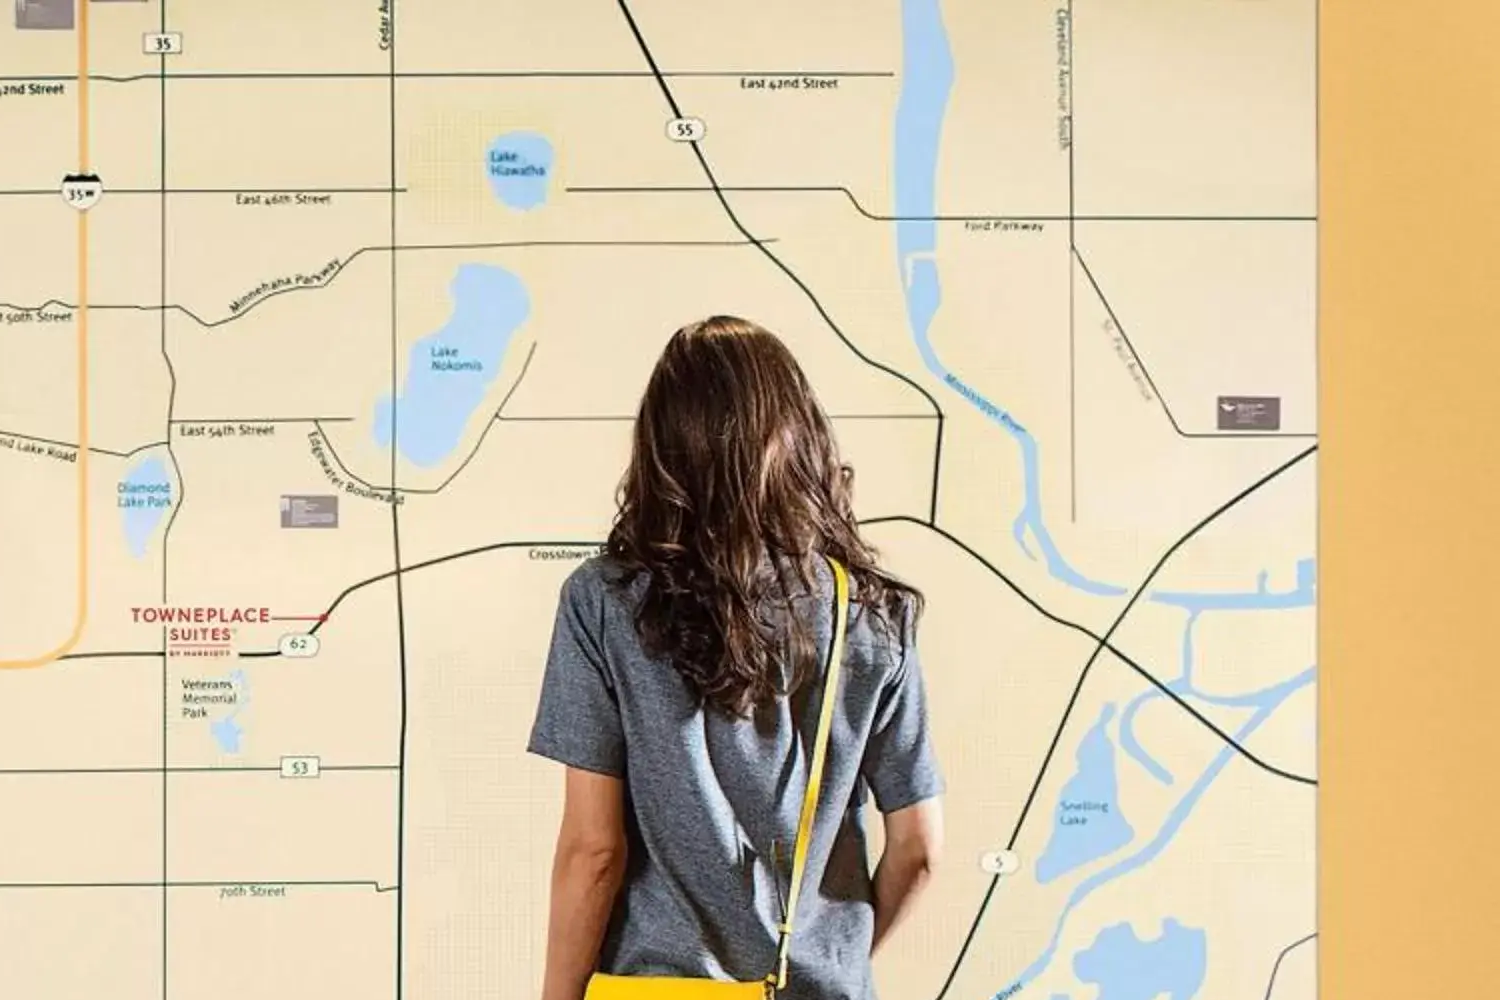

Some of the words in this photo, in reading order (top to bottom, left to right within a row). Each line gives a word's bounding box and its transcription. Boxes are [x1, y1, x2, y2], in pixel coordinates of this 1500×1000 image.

[379, 16, 389, 51] Cedar
[155, 38, 171, 50] 35
[28, 84, 64, 95] Street
[741, 78, 765, 89] East
[768, 77, 800, 90] 42nd
[803, 78, 838, 89] Street
[677, 124, 693, 136] 55
[491, 150, 518, 162] Lake
[491, 164, 546, 177] Hiawatha
[67, 188, 94, 201] 35W
[236, 194, 261, 205] East
[295, 194, 331, 205] Street
[228, 277, 292, 313] Minnehaha
[295, 257, 341, 285] Parkway
[36, 312, 72, 322] Street
[432, 347, 459, 358] Lake
[432, 360, 483, 371] Nokomis
[180, 426, 204, 437] East
[238, 425, 274, 436] Street
[17, 439, 44, 456] Lake
[48, 448, 77, 463] Road
[307, 430, 345, 489] Edgewater
[345, 480, 405, 505] Boulevard
[118, 483, 170, 494] Diamond
[118, 497, 144, 508] Lake
[147, 497, 171, 508] Park
[529, 549, 592, 560] Crosstown
[131, 608, 270, 623] TOWNEPLACE
[290, 639, 307, 650] 62
[181, 680, 232, 690] Veterans
[182, 693, 237, 704] Memorial
[182, 706, 208, 718] Park
[292, 762, 309, 774] 53
[1060, 800, 1108, 813] Snelling
[1060, 814, 1087, 825] Lake
[995, 856, 1003, 868] 5
[250, 886, 285, 897] Street
